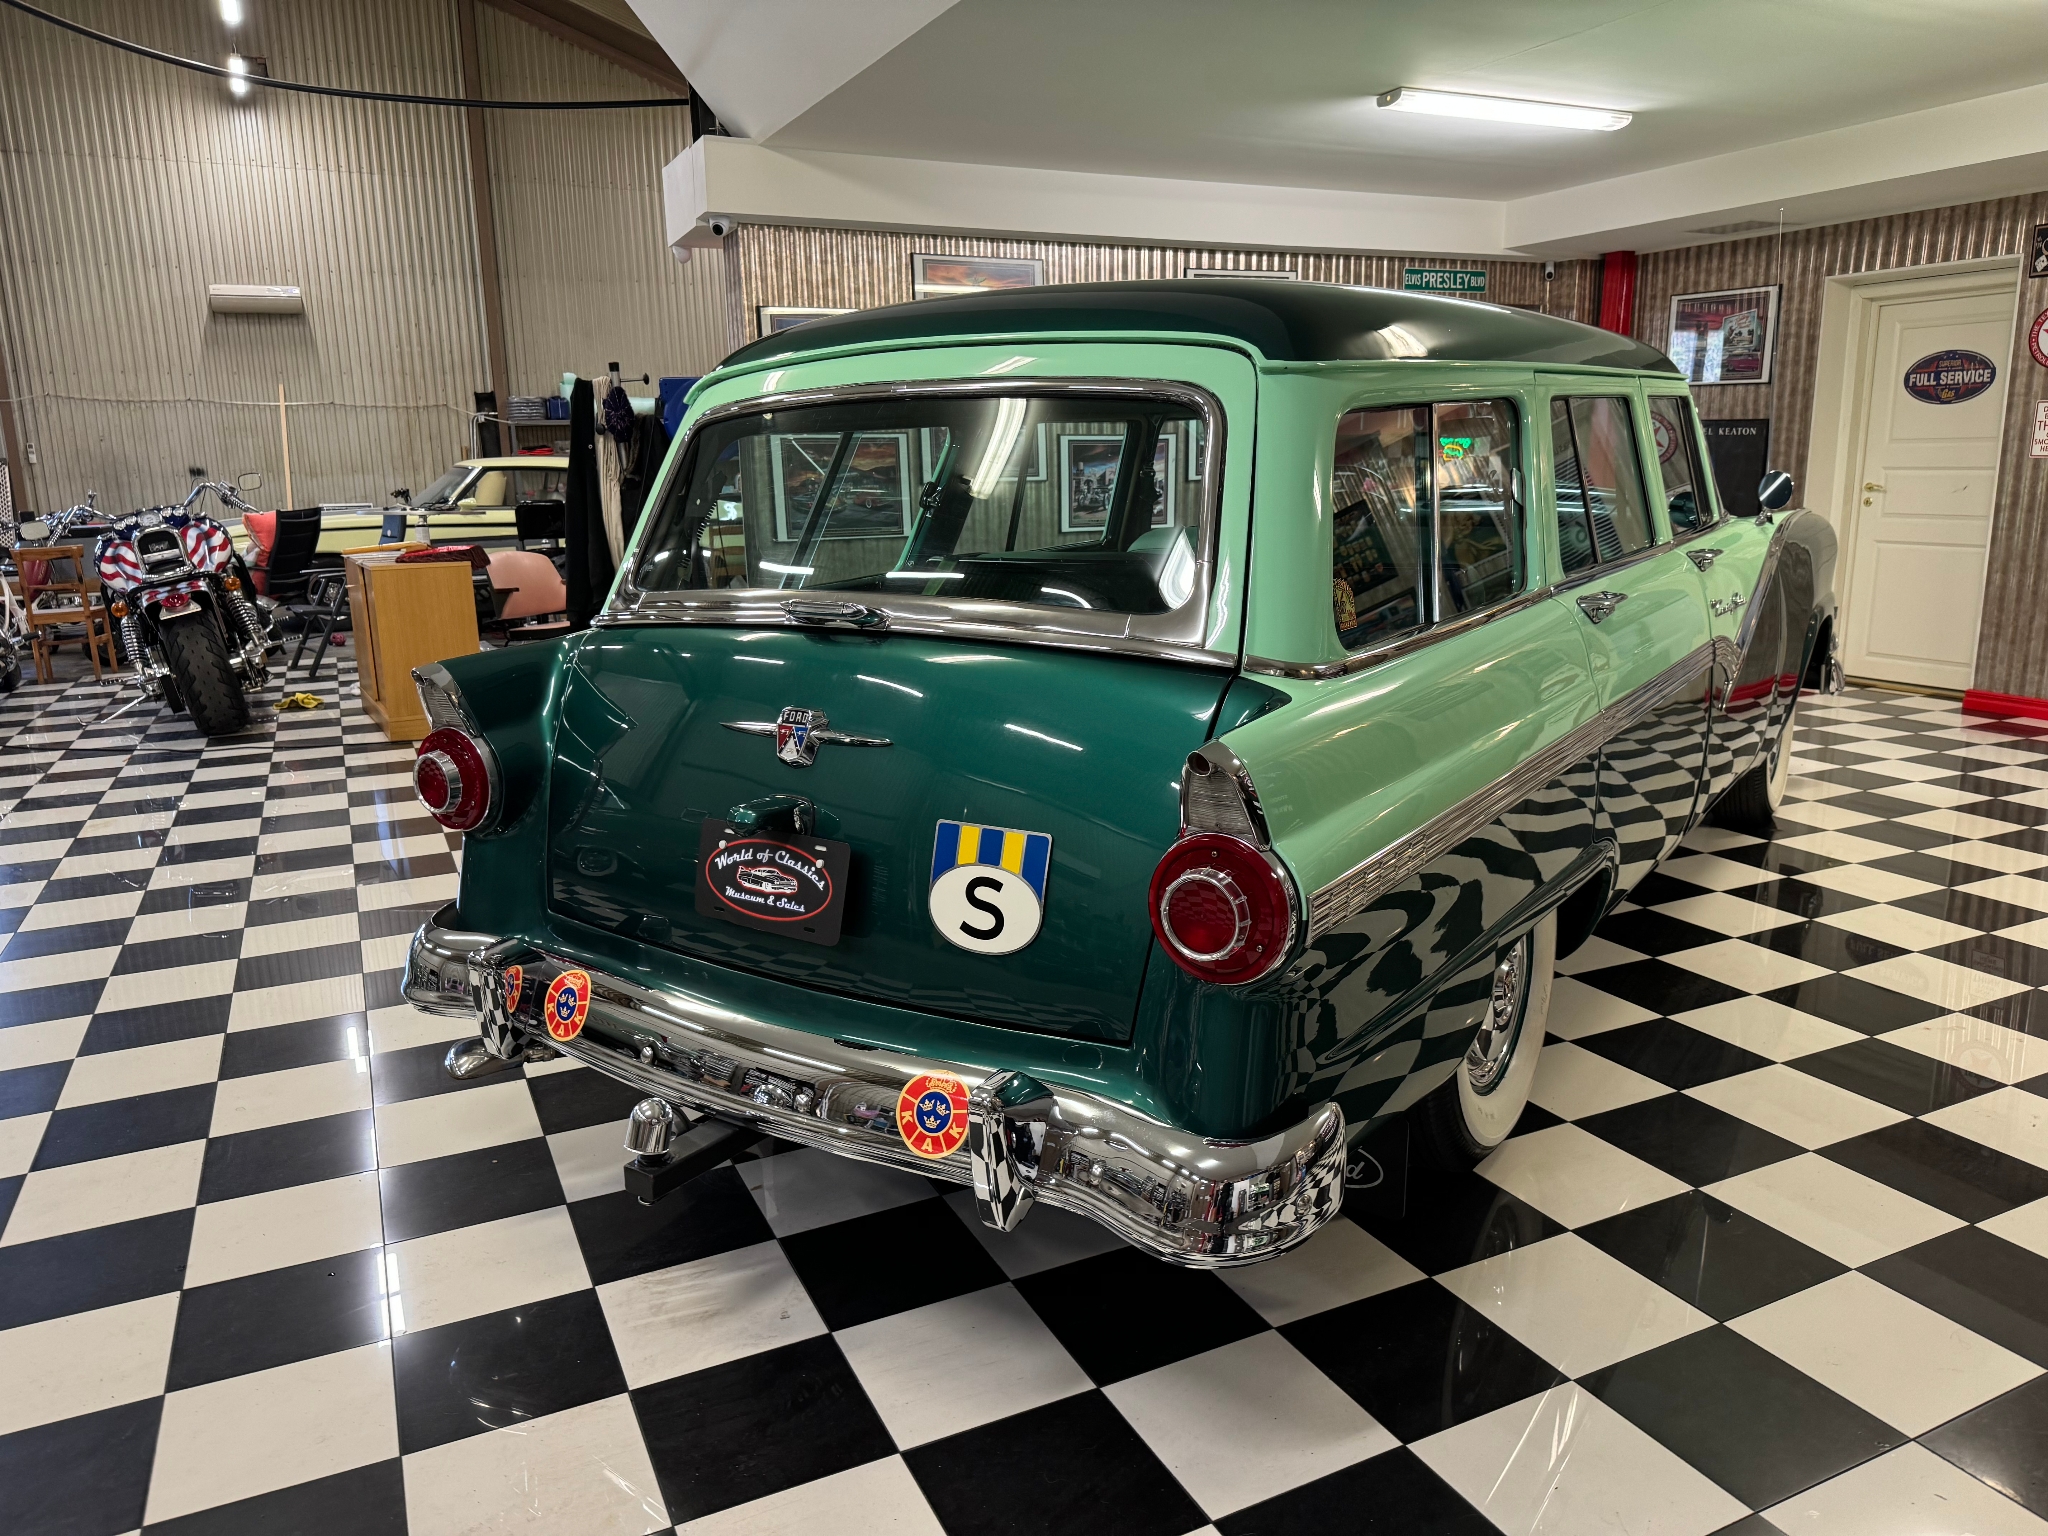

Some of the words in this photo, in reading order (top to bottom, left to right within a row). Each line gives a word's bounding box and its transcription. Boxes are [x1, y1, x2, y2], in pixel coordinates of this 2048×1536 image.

[1405, 273, 1421, 285] ELVIS
[1422, 272, 1470, 289] PRESLEY
[1470, 276, 1485, 287] BLVD
[1909, 372, 1937, 387] FULL
[1940, 369, 1992, 386] SERVICE
[1718, 427, 1757, 436] KEATON
[783, 711, 809, 723] FORD
[715, 848, 753, 870] World
[756, 849, 773, 863] of
[775, 850, 825, 891] Classics
[725, 886, 765, 904] Museum
[766, 895, 775, 905] &
[776, 897, 805, 912] Sales
[959, 876, 1005, 940] S
